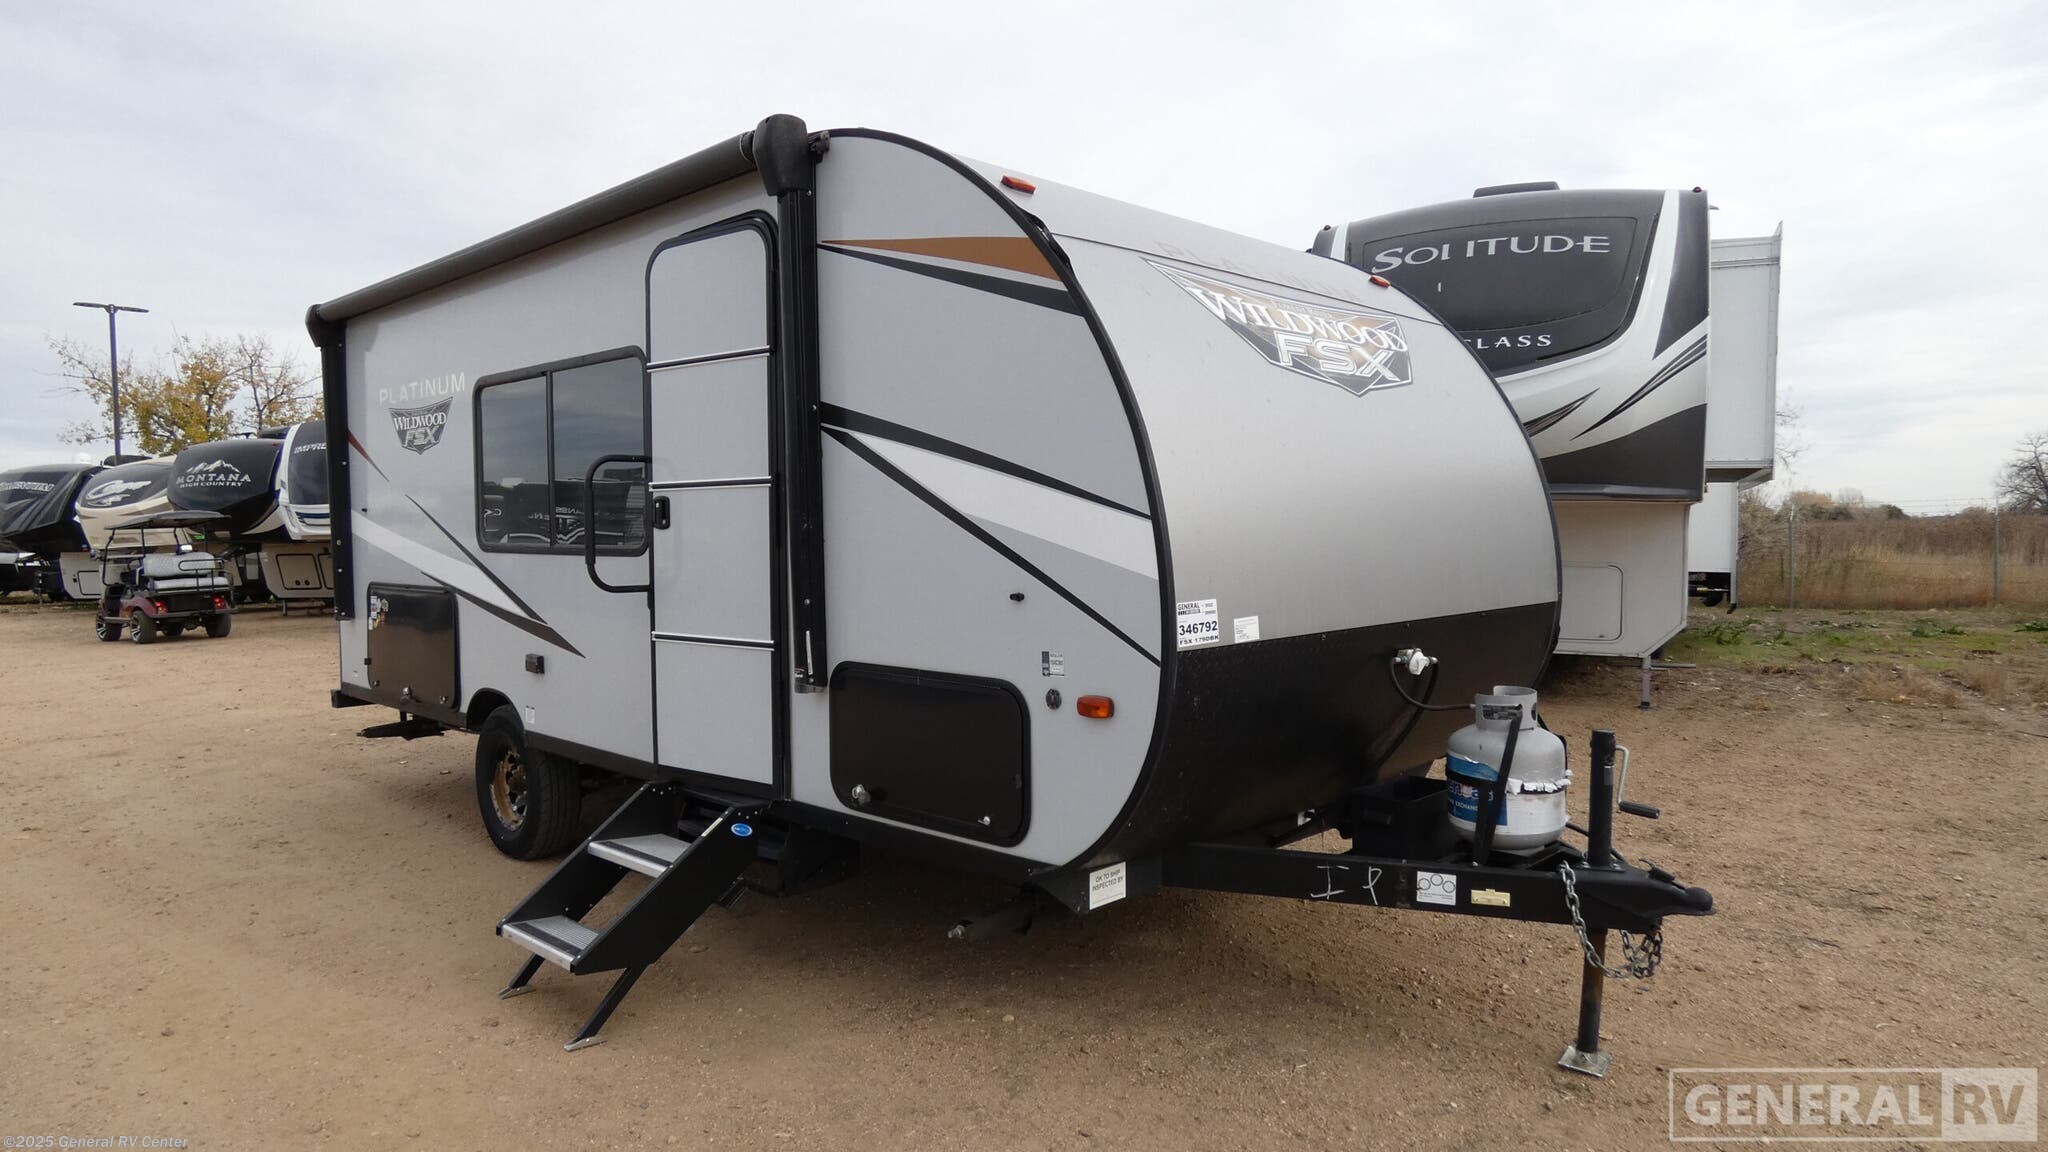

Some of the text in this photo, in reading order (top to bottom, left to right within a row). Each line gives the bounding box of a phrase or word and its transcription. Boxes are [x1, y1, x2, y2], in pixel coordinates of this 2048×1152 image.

[1371, 235, 1611, 273] SOLITUDE
[1184, 286, 1408, 352] WILDWOOD
[1274, 331, 1400, 382] FSX
[379, 371, 465, 406] PLATINUM
[394, 412, 447, 431] WILDWOOD
[404, 426, 439, 447] FSX
[176, 473, 251, 484] MONTANA
[1178, 603, 1200, 611] GENERAL
[1179, 621, 1218, 636] 346792
